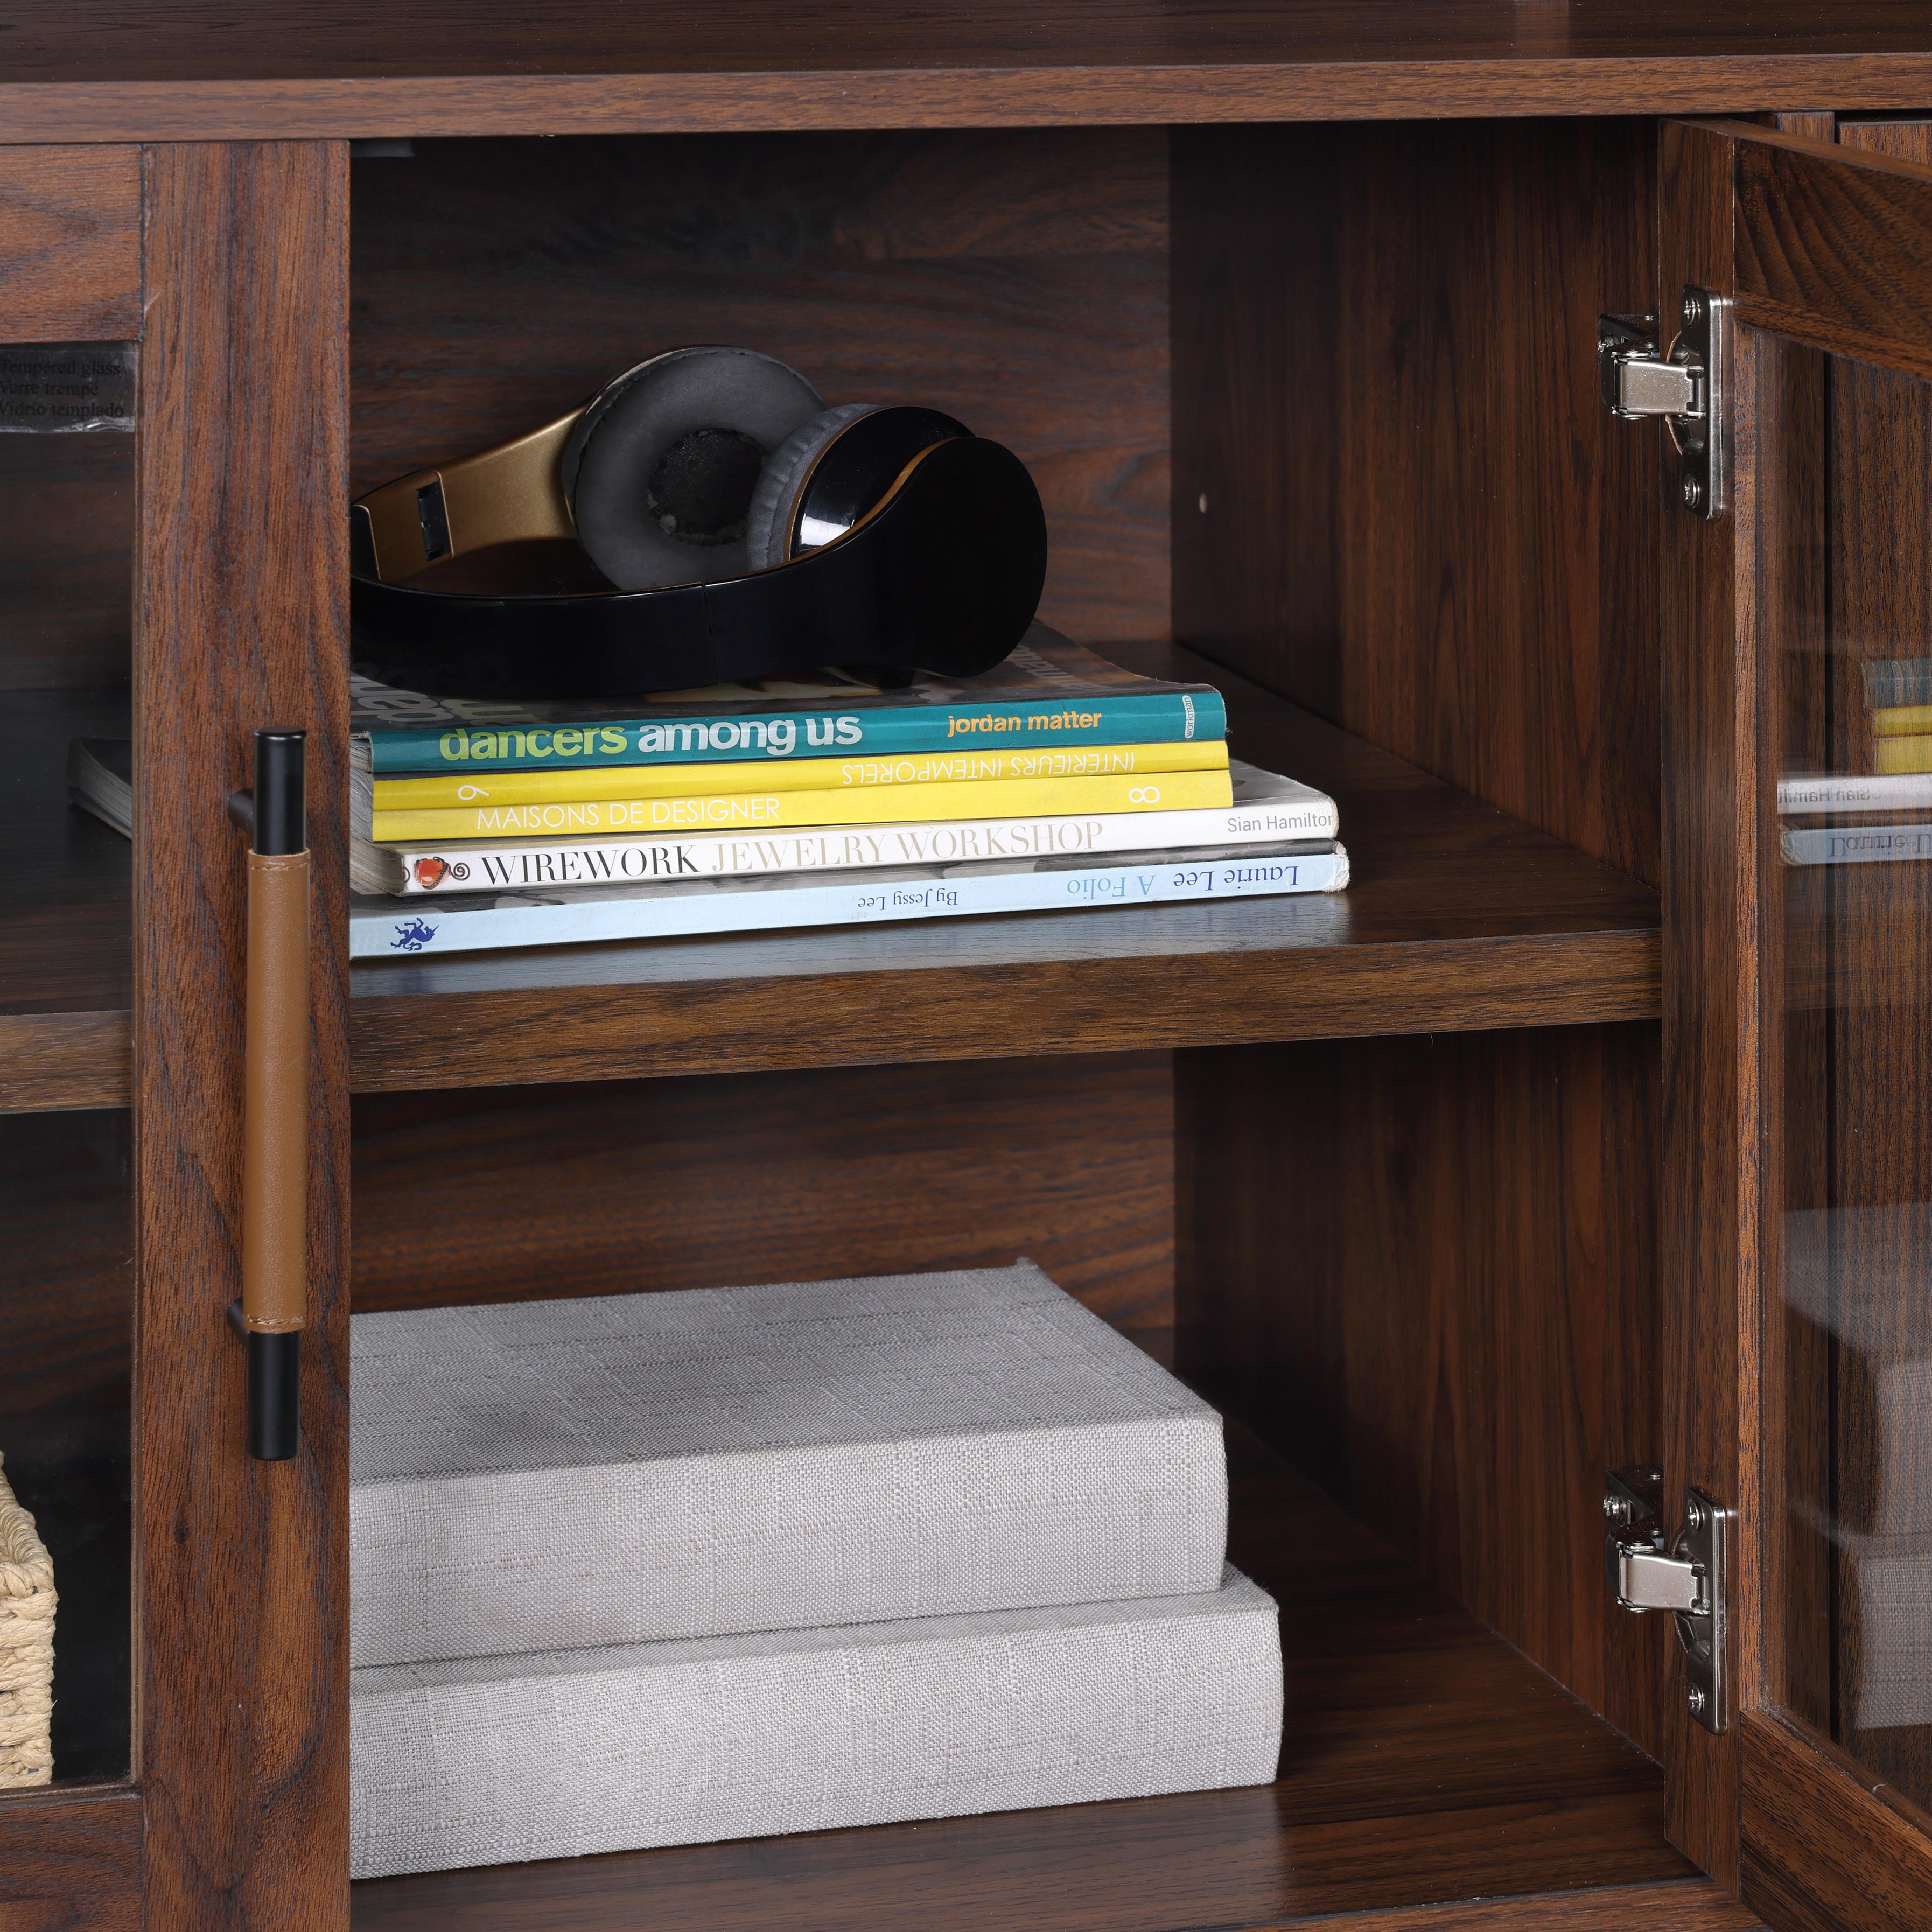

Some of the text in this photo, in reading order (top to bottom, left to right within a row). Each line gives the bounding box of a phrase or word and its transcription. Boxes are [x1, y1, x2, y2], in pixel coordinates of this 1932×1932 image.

[0, 359, 121, 378] Tempered glass
[0, 380, 100, 399] Verre trempé
[0, 401, 124, 420] Vidrio templado
[947, 710, 1102, 738] jordan matter
[1184, 697, 1194, 737] workman
[439, 716, 863, 761] dancers among us
[842, 752, 1135, 785] INTÉRIEURS INTEMPORELS
[1128, 786, 1160, 804] 8
[477, 797, 780, 830] MAISONS DE DESIGNER
[1228, 817, 1261, 832] Sian
[478, 821, 1103, 885] WIREWORK JEWELRY WORKSHOP
[1067, 874, 1157, 900] A Folio
[1173, 866, 1300, 891] Laurie Lee
[857, 888, 958, 911] By Jessy Lee
